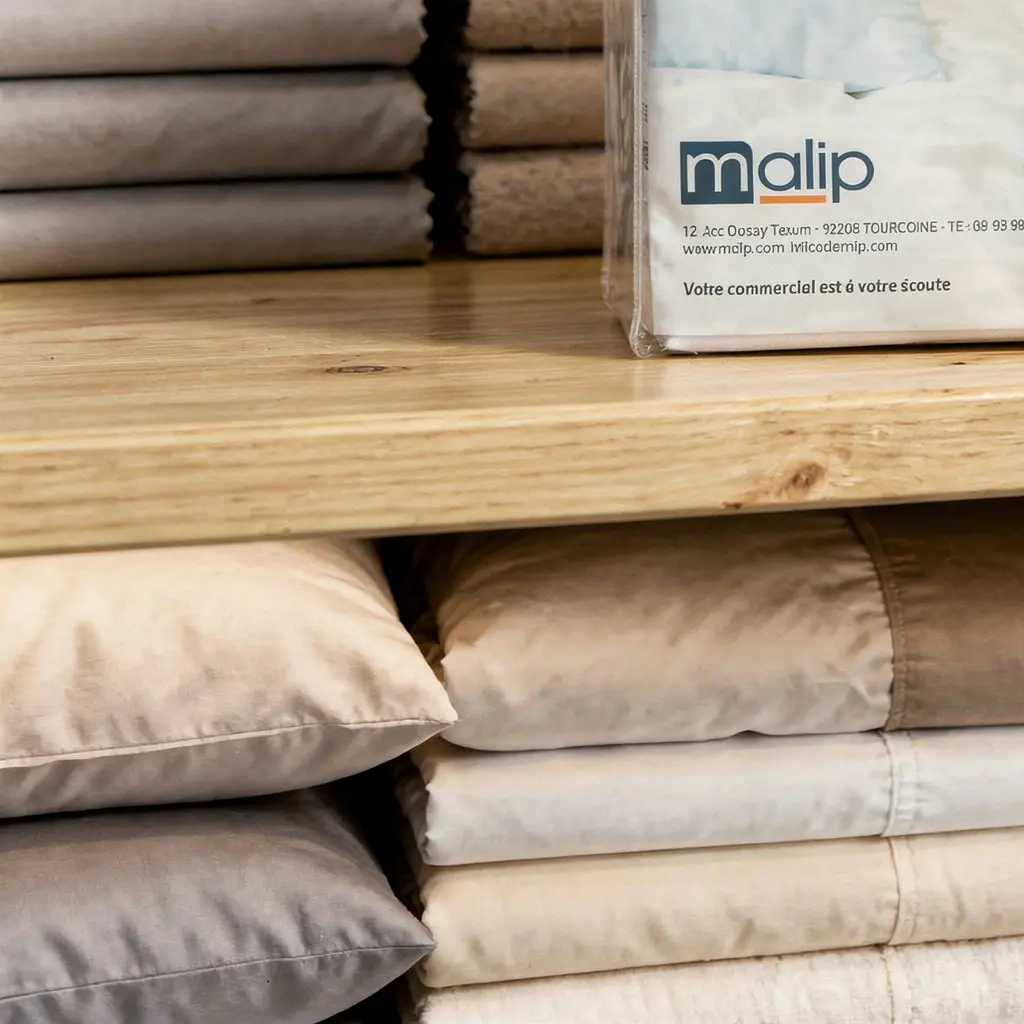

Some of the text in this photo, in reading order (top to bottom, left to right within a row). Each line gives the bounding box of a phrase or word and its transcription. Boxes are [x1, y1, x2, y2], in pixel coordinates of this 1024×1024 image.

[680, 138, 875, 205] malip
[683, 225, 697, 237] 12
[822, 222, 860, 235] 92208
[727, 280, 816, 295] commercial
[819, 280, 842, 293] est
[858, 279, 897, 293] votre
